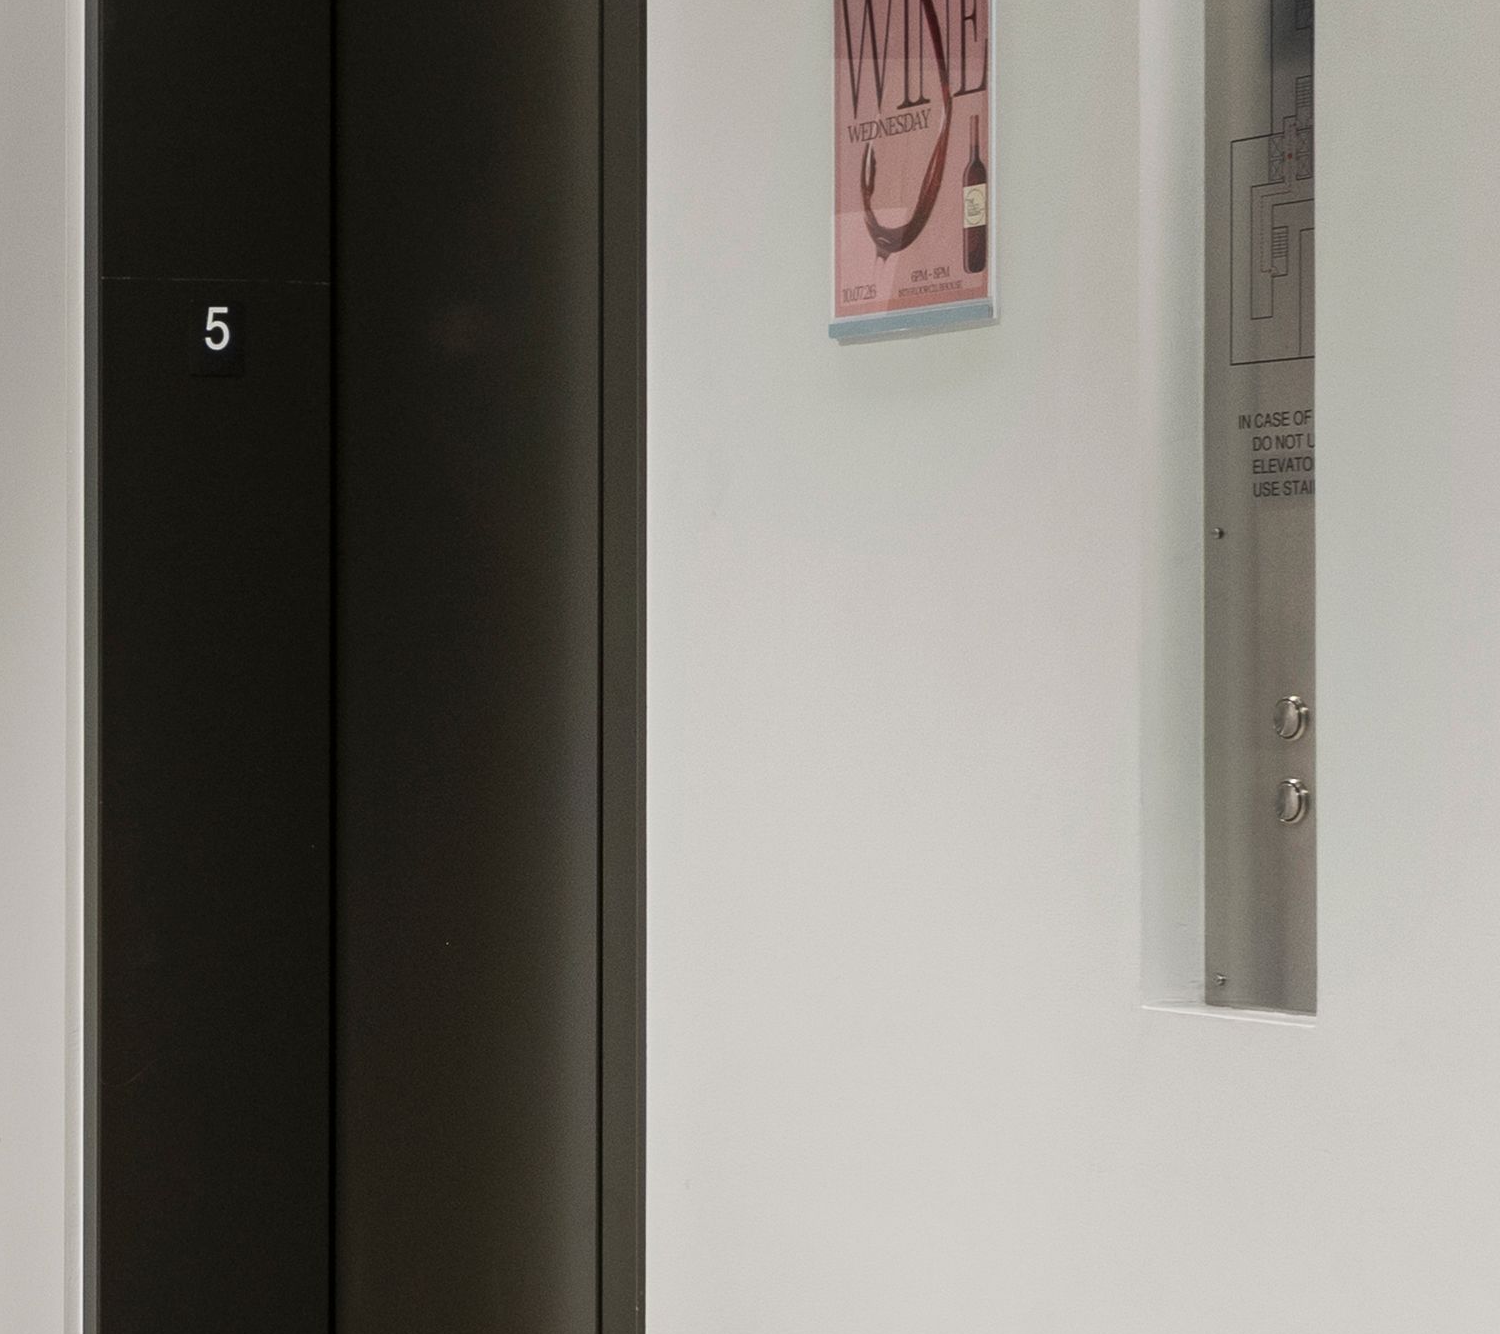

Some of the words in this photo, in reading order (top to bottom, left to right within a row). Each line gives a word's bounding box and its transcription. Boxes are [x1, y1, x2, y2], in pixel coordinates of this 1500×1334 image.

[847, 108, 931, 143] WEDNESDAY
[204, 306, 230, 351] 5
[1238, 414, 1252, 429] IN
[1254, 411, 1290, 429] CASE
[1293, 409, 1313, 427] OF
[1252, 435, 1272, 451] DO
[1276, 433, 1304, 450] NOT
[1253, 481, 1280, 498] USE
[1283, 480, 1315, 495] STAI
